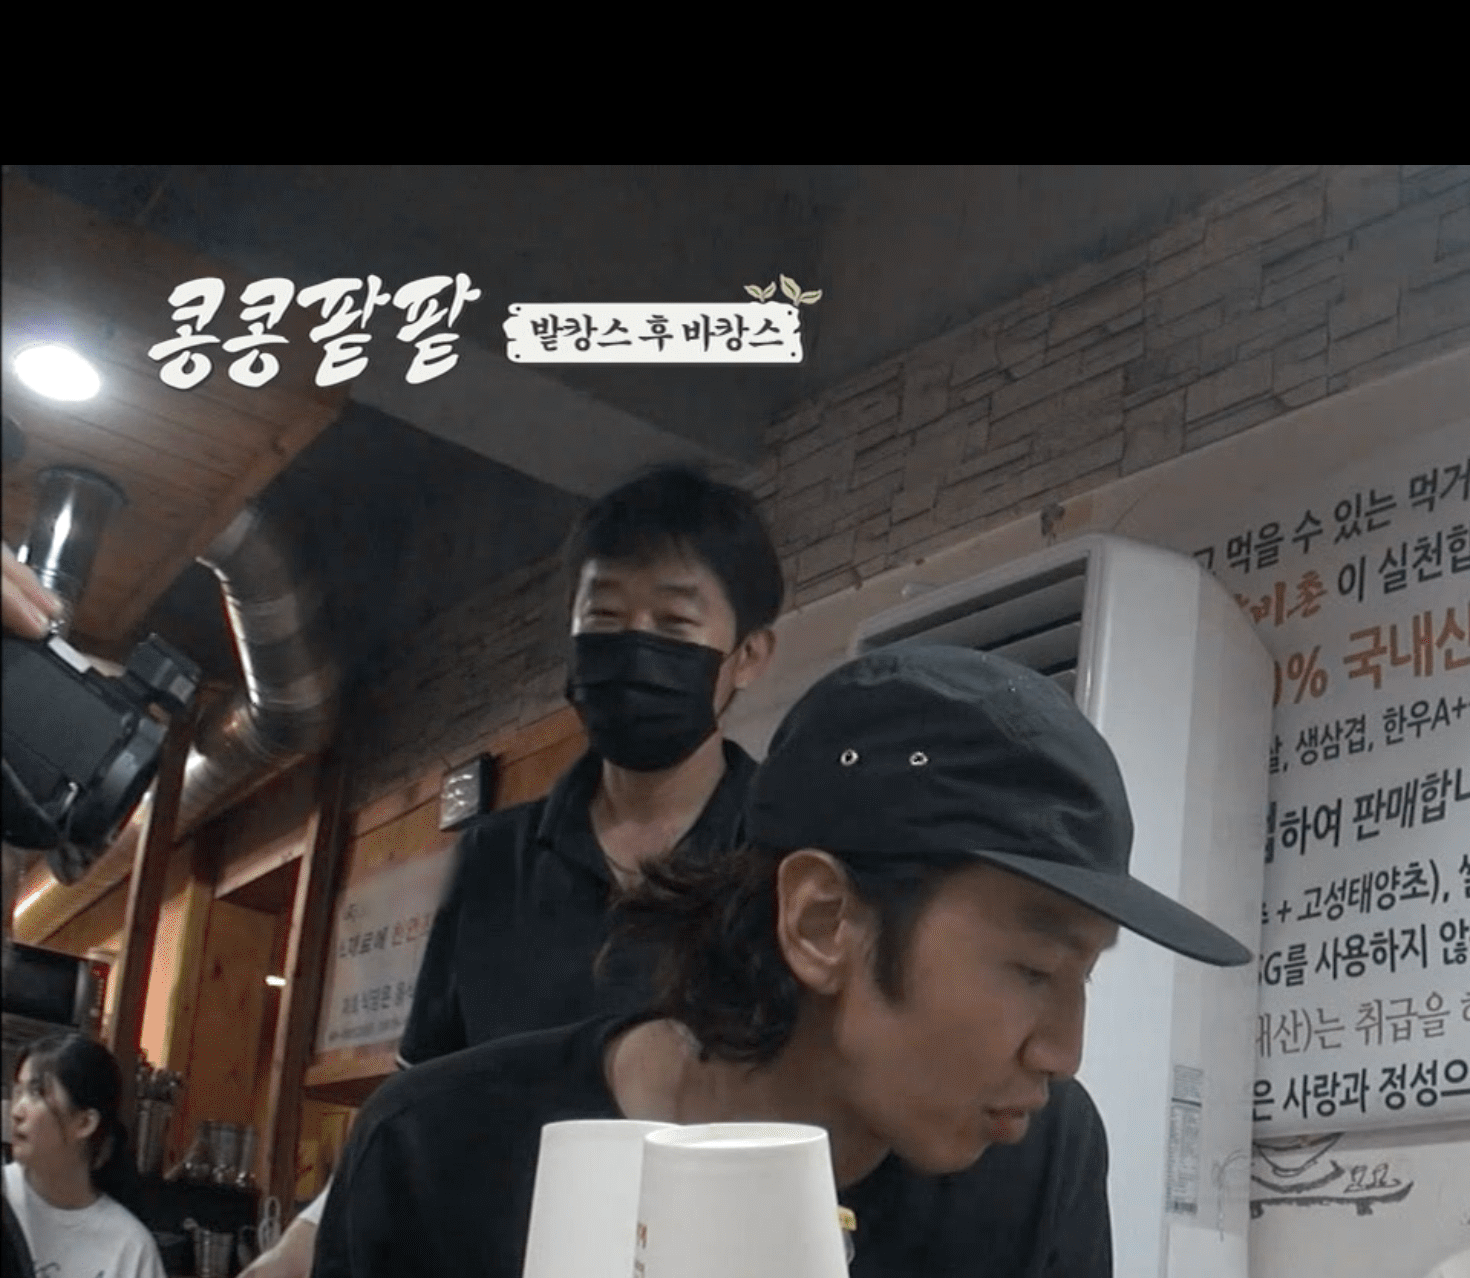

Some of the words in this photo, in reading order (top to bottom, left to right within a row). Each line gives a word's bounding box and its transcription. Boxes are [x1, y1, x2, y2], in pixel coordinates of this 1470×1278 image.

[1226, 520, 1284, 575] 먹을
[1291, 508, 1324, 555] 수
[1333, 487, 1398, 546] 있는
[1232, 569, 1328, 627] 비촌
[1337, 555, 1368, 603] 이
[1295, 713, 1375, 767] 생삼겹,
[1296, 857, 1451, 923] 고성태양초),
[1258, 942, 1308, 988] G를
[1315, 922, 1428, 982] 사용하지
[1354, 990, 1452, 1047] 취급을
[1282, 1066, 1371, 1120] 사랑과
